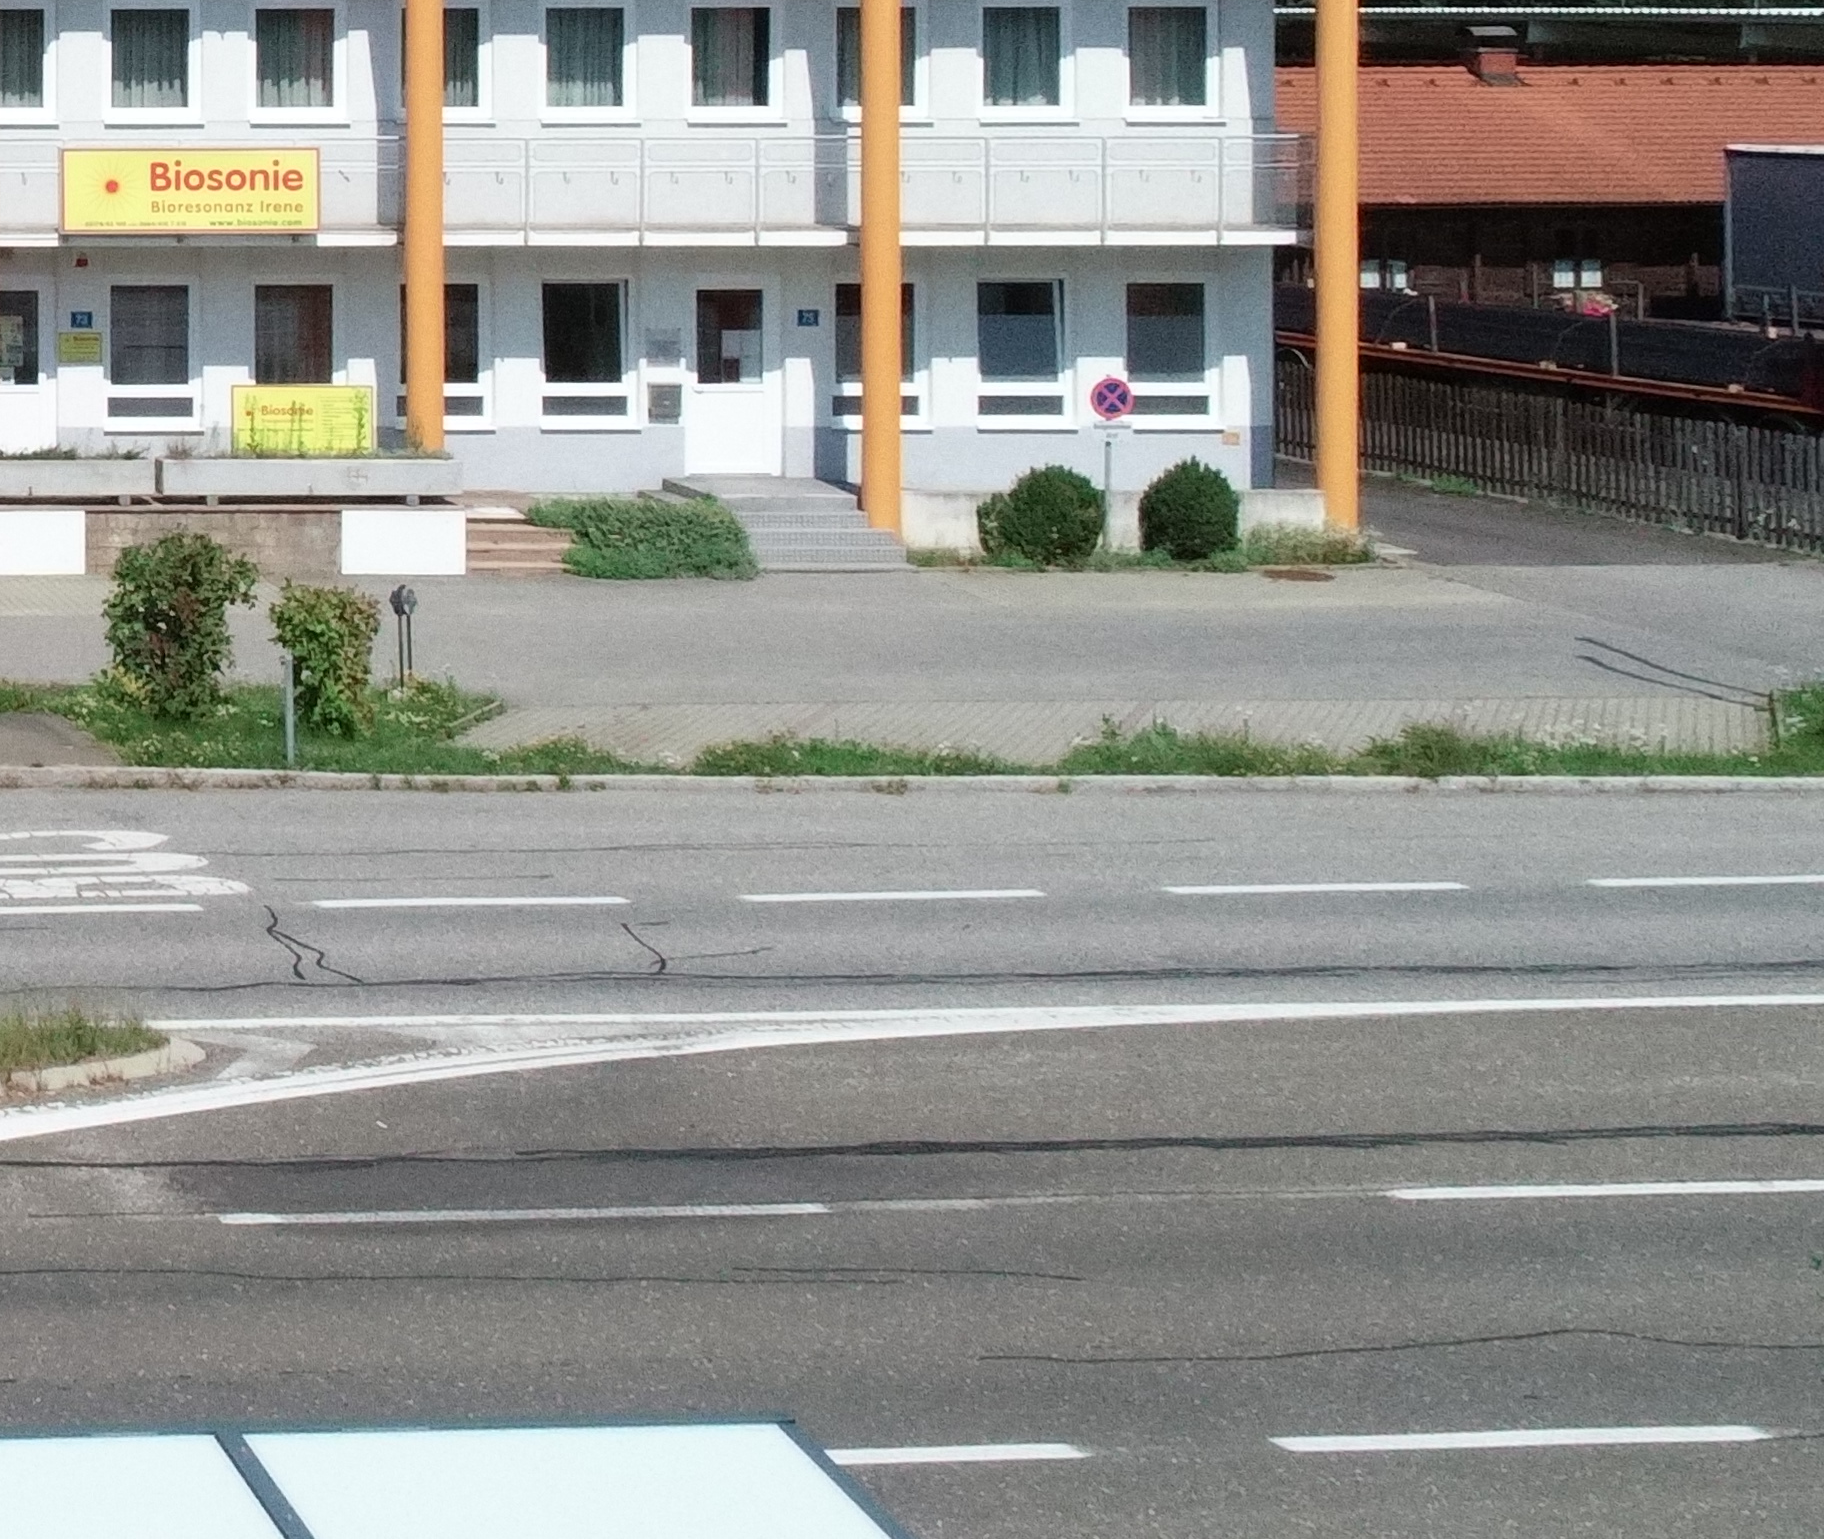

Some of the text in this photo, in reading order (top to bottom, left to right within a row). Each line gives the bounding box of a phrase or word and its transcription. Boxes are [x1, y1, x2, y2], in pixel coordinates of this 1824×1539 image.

[149, 159, 304, 192] Biosonie
[151, 200, 304, 213] Bioresonanz Irene
